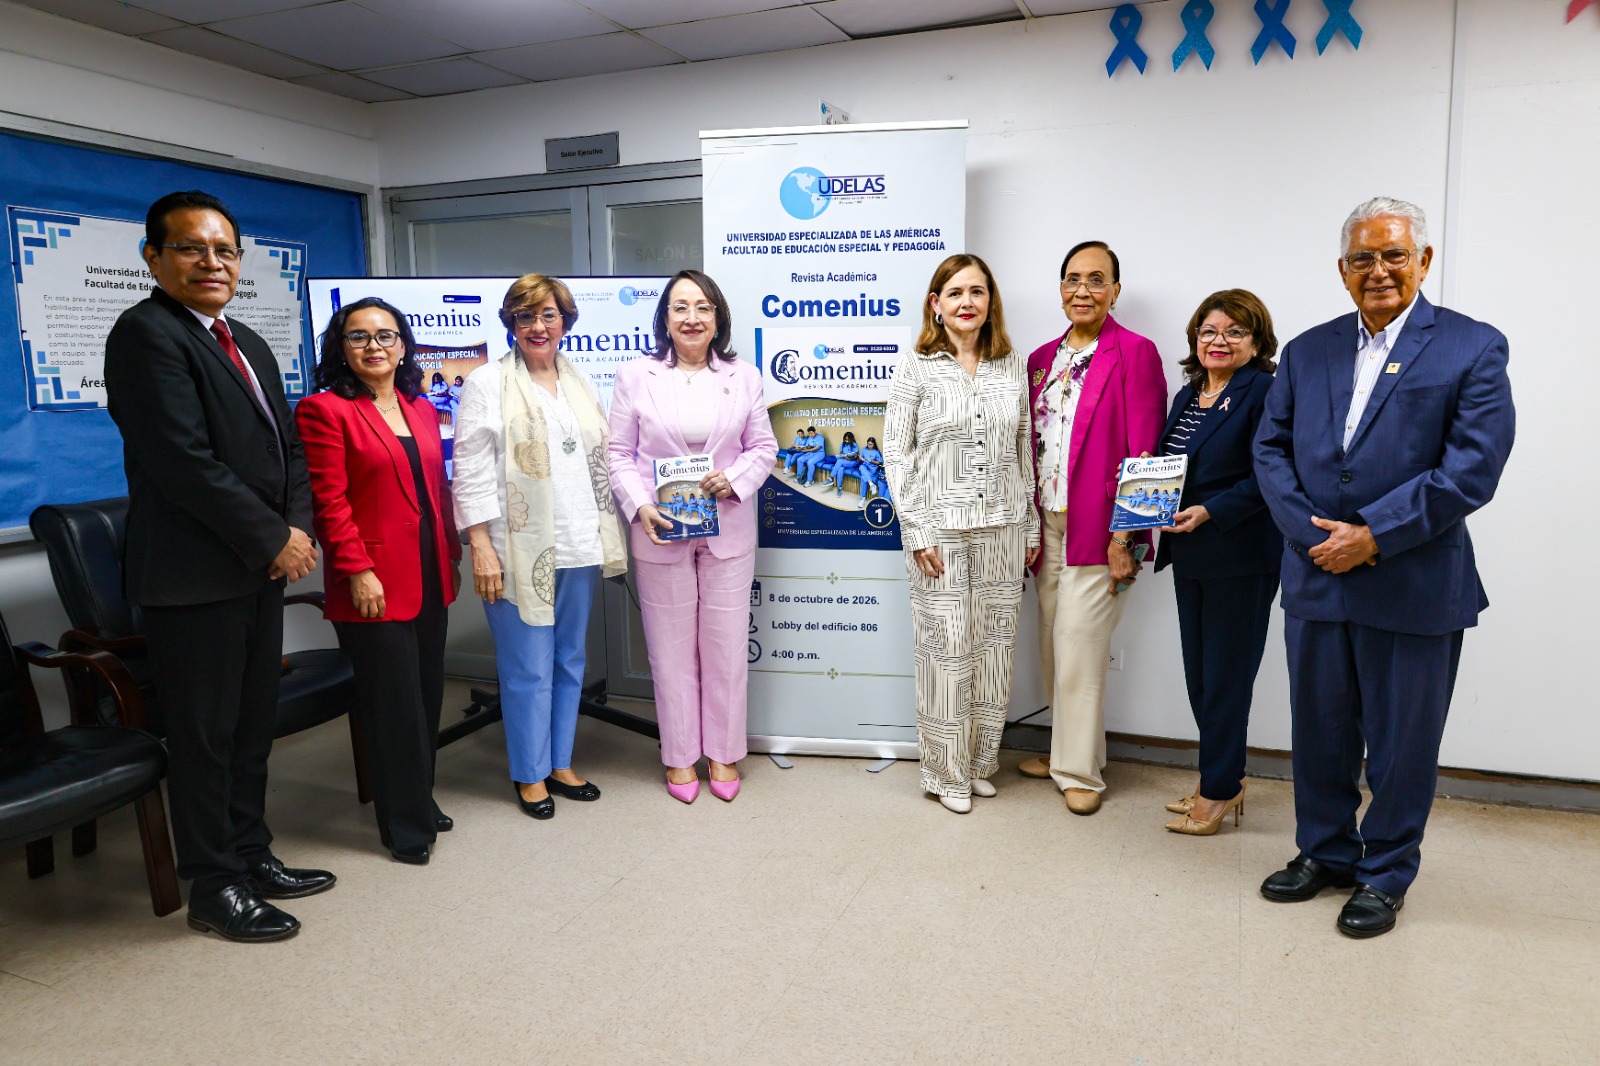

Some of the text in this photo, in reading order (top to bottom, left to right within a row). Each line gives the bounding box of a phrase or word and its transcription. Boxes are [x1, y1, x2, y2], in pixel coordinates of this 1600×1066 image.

[577, 148, 603, 158] Ejecutivo
[818, 176, 886, 194] UDELAS
[726, 226, 941, 242] UNIVERSIDAD ESPECIALIZADA DE LAS AMÉRICAS
[722, 239, 946, 255] FACULTAD DE EDUCACIÓN ESPECIAL Y PEDAGOGÍA
[86, 265, 140, 278] Universidad
[791, 270, 877, 283] Revista Académica
[84, 279, 124, 290] Facultad
[127, 282, 137, 290] de
[238, 278, 255, 286] ricas
[235, 290, 258, 299] agogía
[762, 292, 900, 318] Comenius
[404, 308, 481, 327] menius
[447, 350, 479, 359] ESPECIAL
[770, 349, 896, 384] Comenius
[81, 376, 106, 388] Área
[812, 408, 819, 417] DE
[821, 405, 859, 416] EDUCACIÓN
[860, 407, 886, 416] ESPECI
[808, 418, 812, 426] Y
[659, 463, 710, 478] Comenius
[1127, 462, 1182, 474] Comenius
[875, 508, 883, 523] 1
[769, 594, 880, 605] 8 de octubre de 2026.
[772, 621, 878, 632] Lobby del edificio 806
[771, 650, 820, 661] 4:00 p.m.
